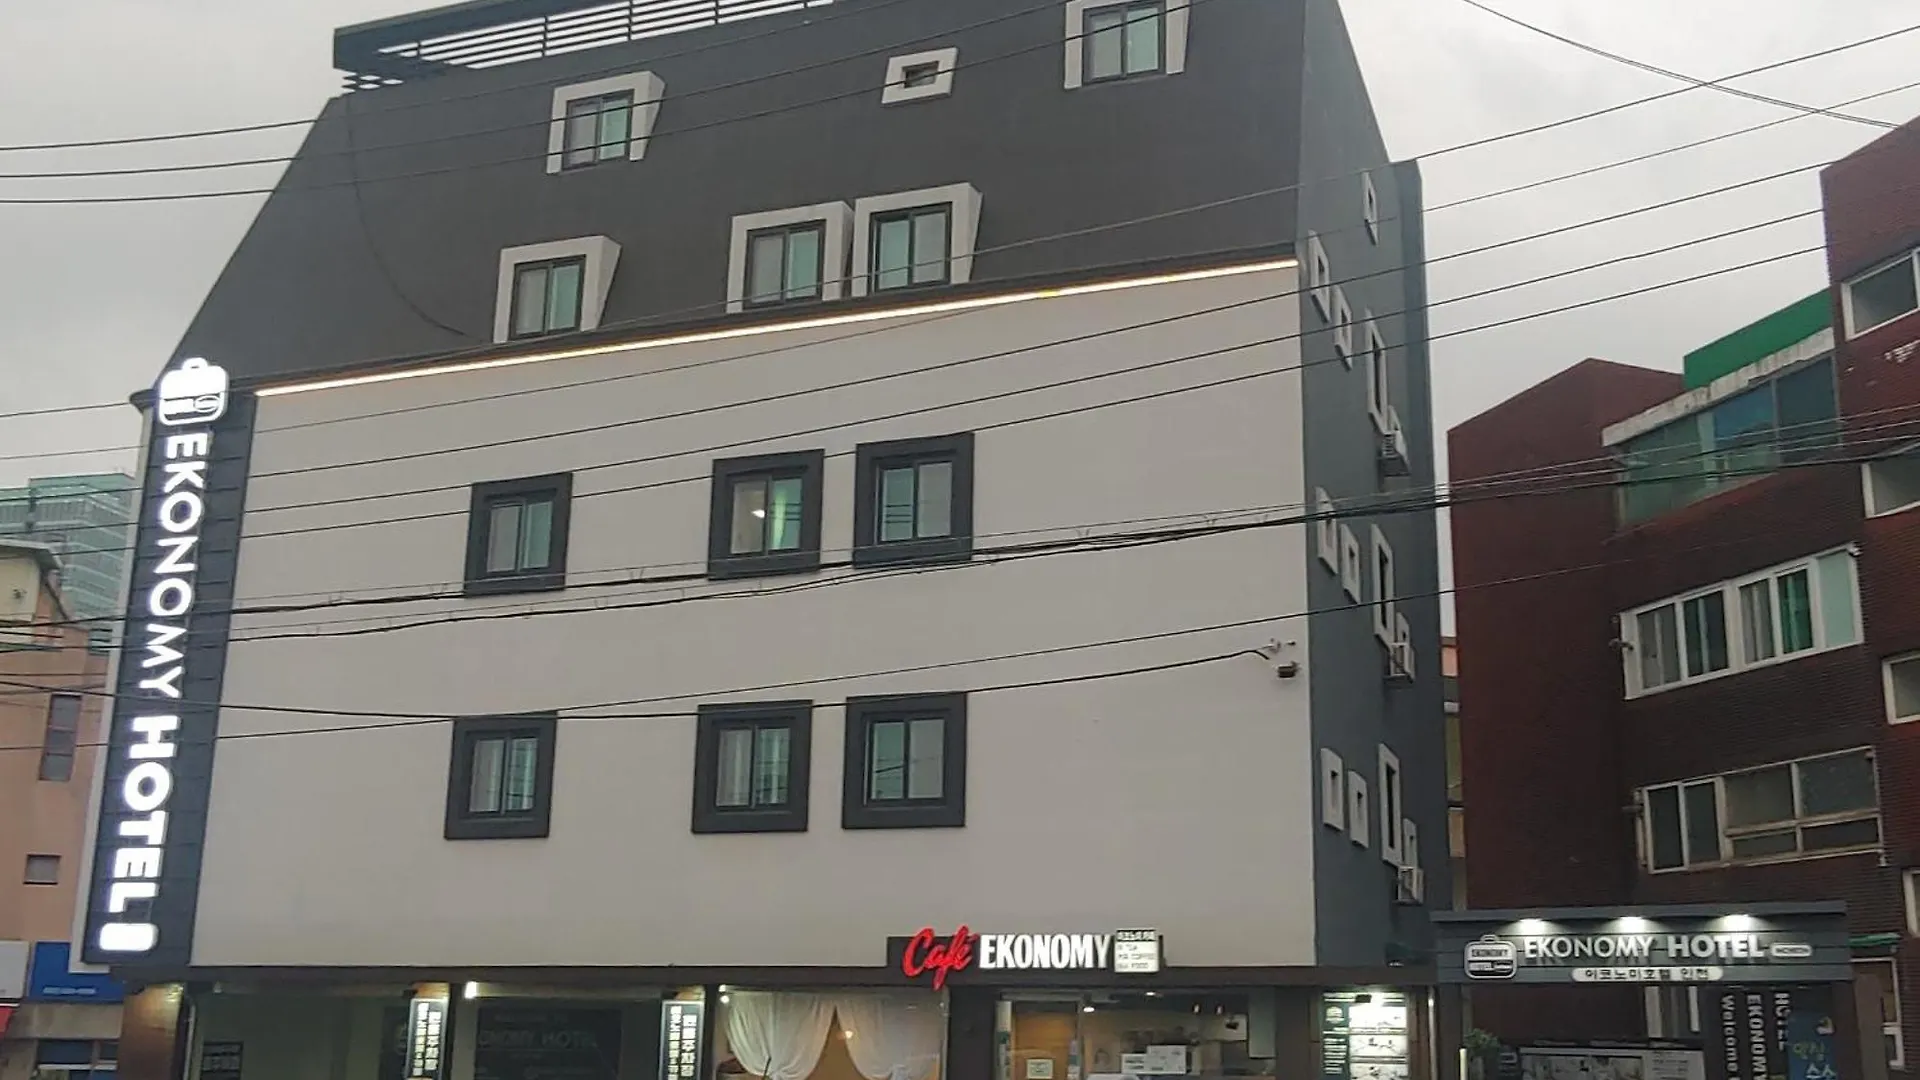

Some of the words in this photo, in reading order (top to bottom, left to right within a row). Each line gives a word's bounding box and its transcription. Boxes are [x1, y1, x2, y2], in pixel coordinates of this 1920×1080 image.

[139, 432, 210, 698] EKONOMY
[108, 715, 180, 913] HOTEL
[979, 934, 1110, 969] EKONOMY
[1525, 935, 1654, 958] EKONOMY
[1667, 934, 1764, 958] HOTEL
